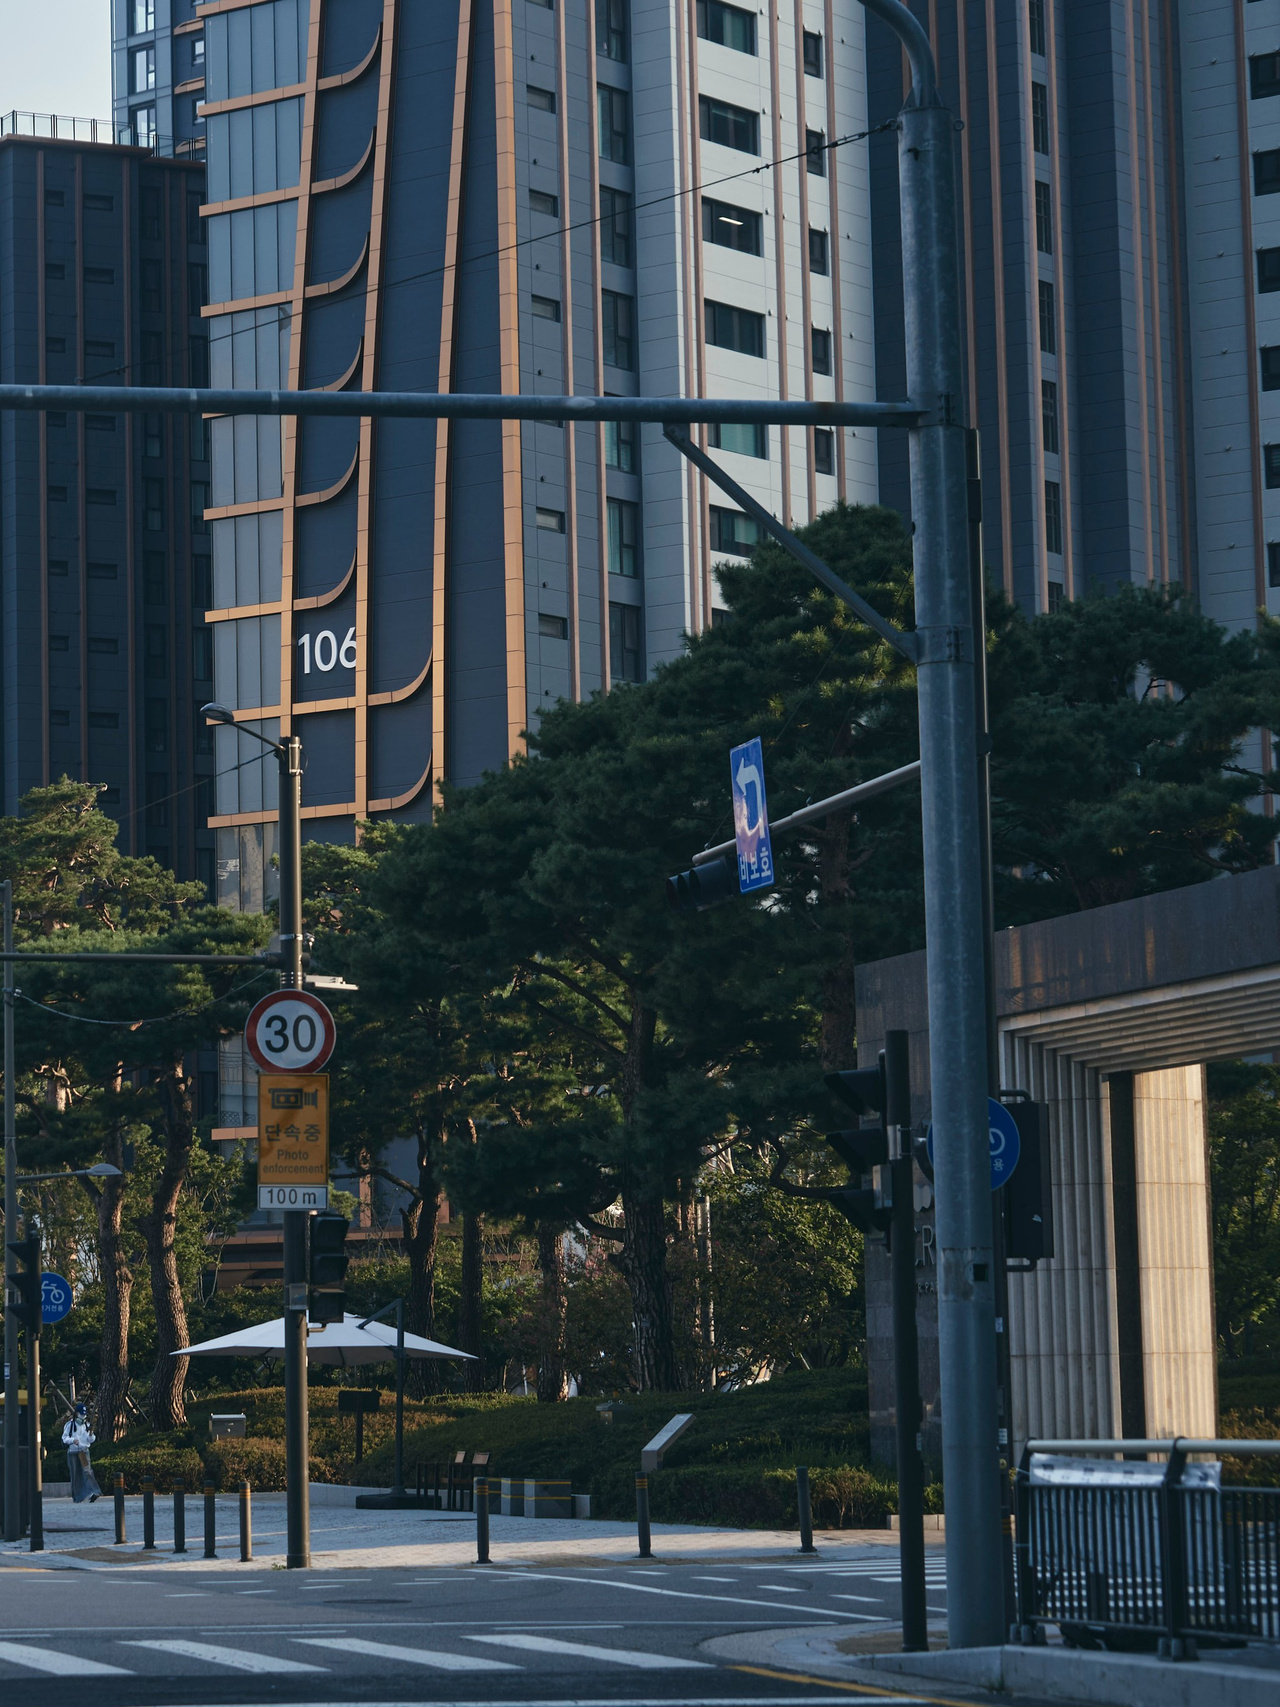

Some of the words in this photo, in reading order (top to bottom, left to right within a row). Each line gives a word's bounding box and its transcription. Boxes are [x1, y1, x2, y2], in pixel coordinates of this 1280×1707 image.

[297, 626, 357, 674] 106
[739, 846, 772, 884] 비보호
[264, 1014, 317, 1053] 30
[264, 1123, 321, 1142] 단속중
[277, 1149, 309, 1161] Photo
[262, 1162, 324, 1175] enforcement
[267, 1188, 298, 1205] 100
[302, 1191, 317, 1205] m
